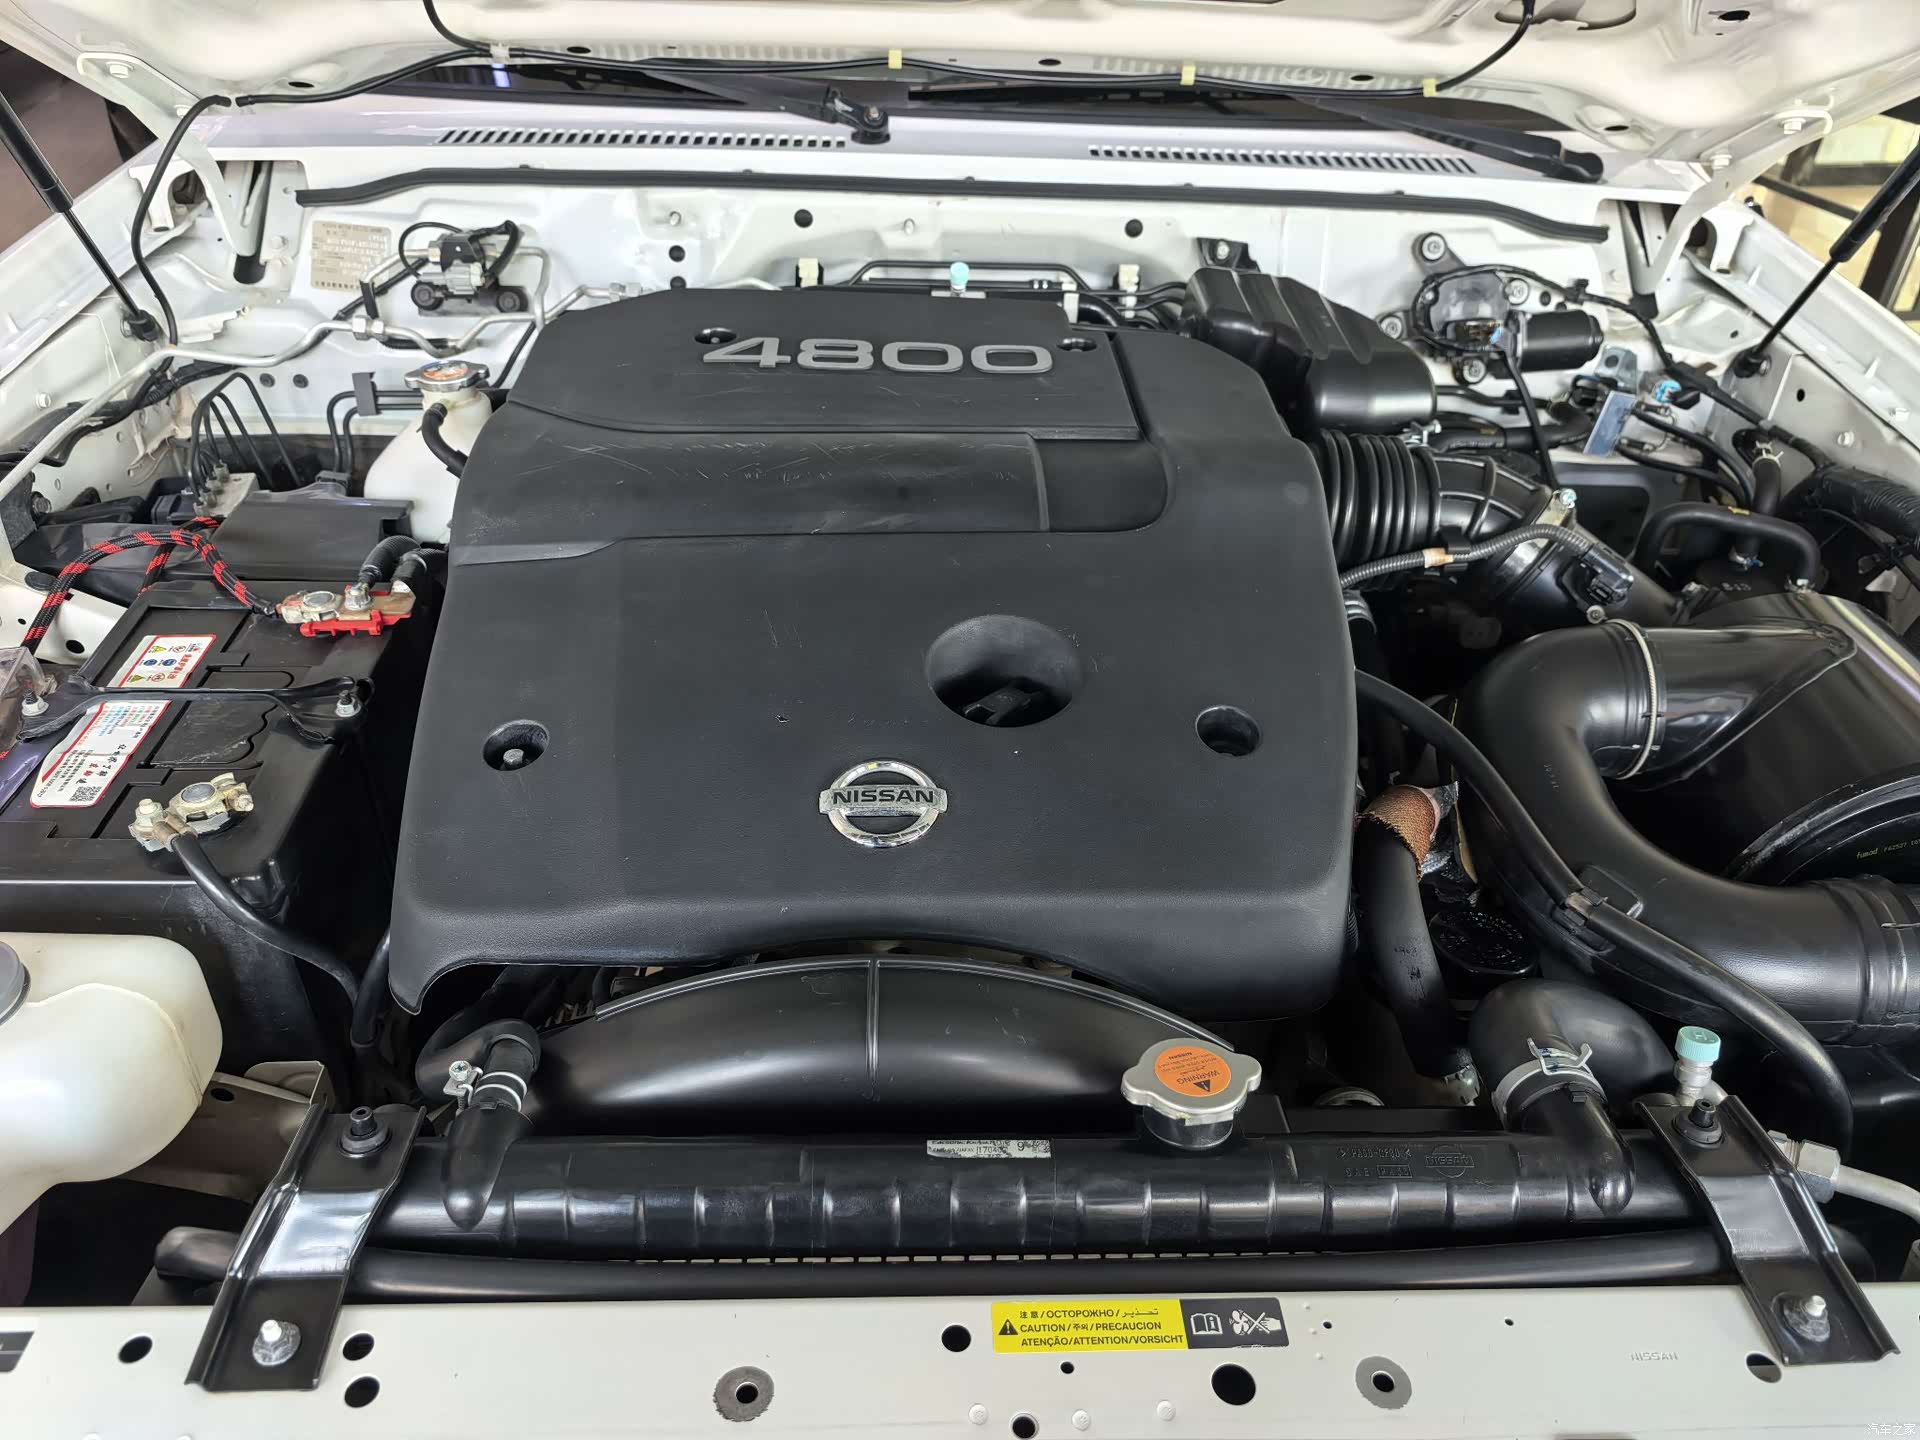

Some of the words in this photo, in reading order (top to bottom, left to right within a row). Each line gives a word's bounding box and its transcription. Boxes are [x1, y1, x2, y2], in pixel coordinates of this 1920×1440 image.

[703, 337, 1053, 374] 4800
[833, 789, 934, 805] NISSAN
[1176, 1069, 1220, 1085] WARNING
[1046, 1309, 1114, 1319] ОСТОРОЖНО
[1020, 1323, 1066, 1333] CAUTION
[1095, 1321, 1162, 1331] PRECAUCION
